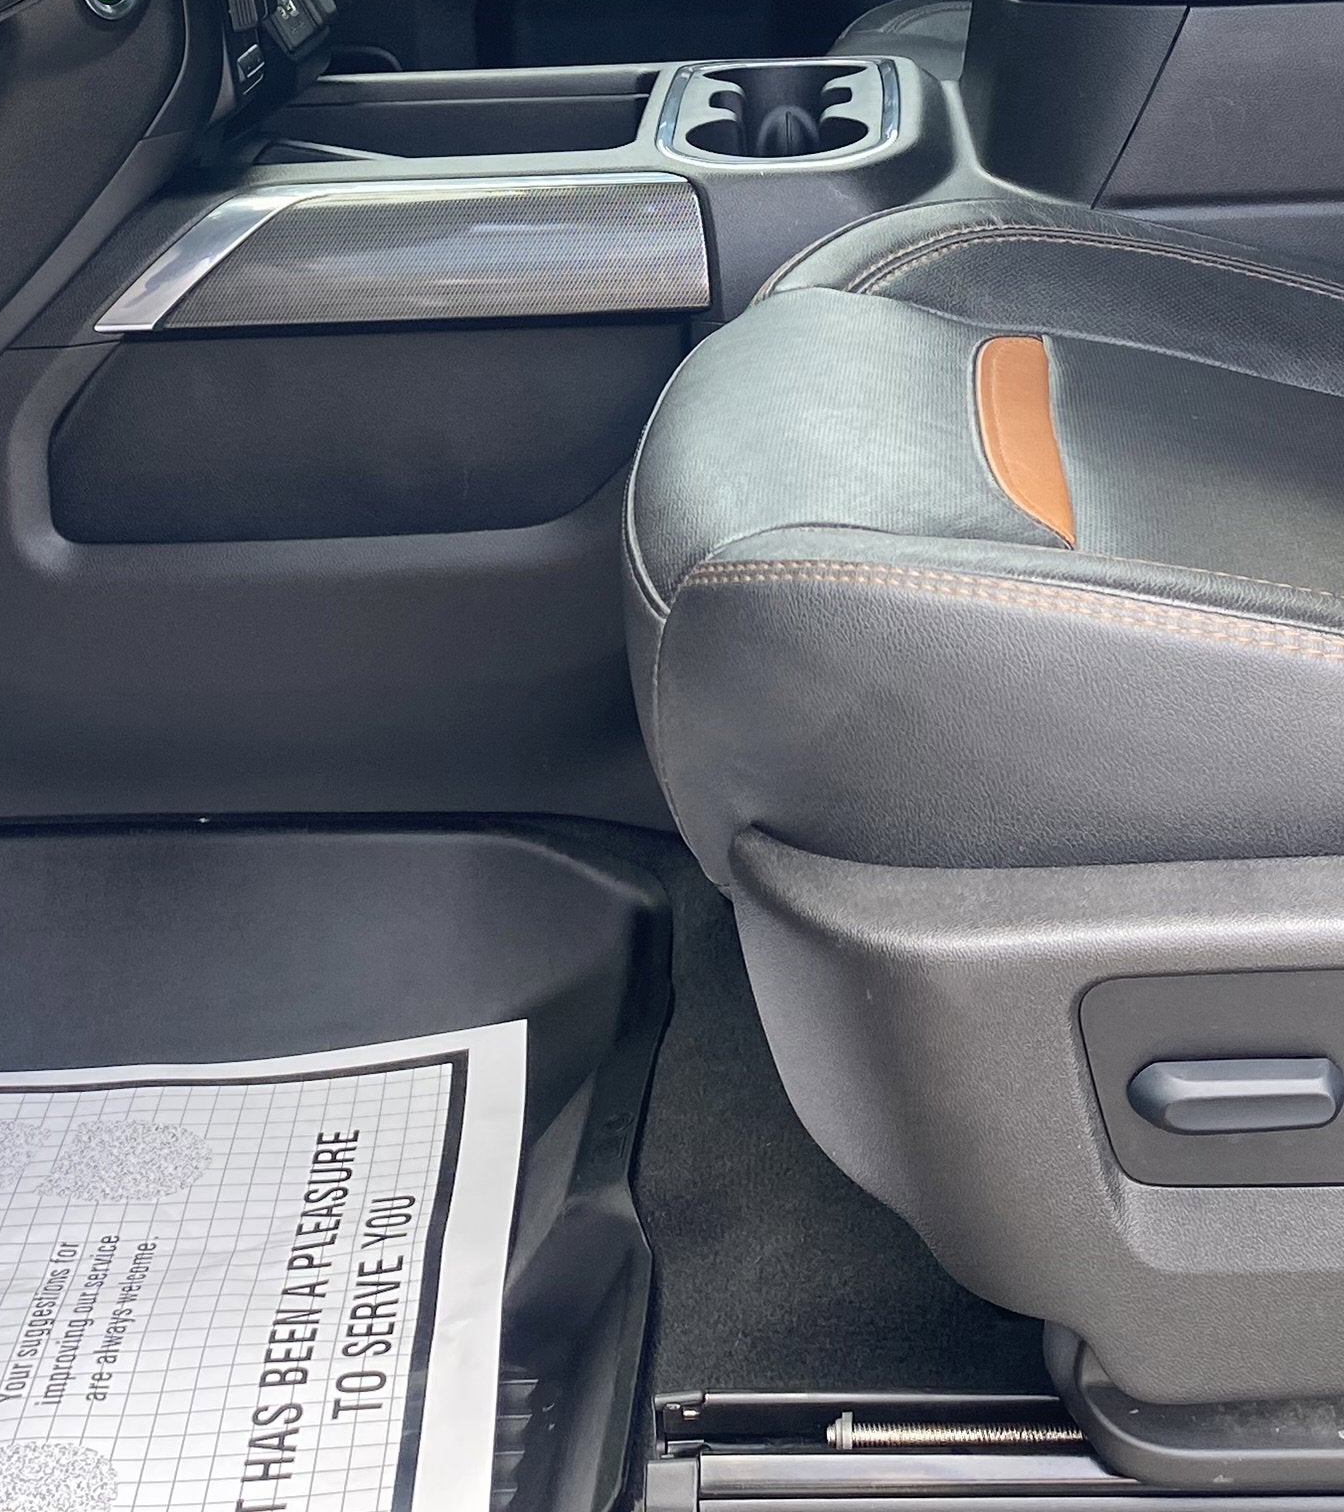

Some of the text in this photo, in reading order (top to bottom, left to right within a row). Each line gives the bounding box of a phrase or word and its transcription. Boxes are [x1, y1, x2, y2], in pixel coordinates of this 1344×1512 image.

[287, 1129, 360, 1271] PLEASURE
[17, 1268, 71, 1358] suggestions
[50, 1242, 79, 1263] for
[34, 1235, 120, 1405] improving our service
[86, 1236, 159, 1402] are always welcome.
[259, 1309, 323, 1388] BEEN
[281, 1279, 329, 1298] A
[331, 1194, 416, 1420] TO SERVE YOU
[241, 1402, 303, 1483] HAS
